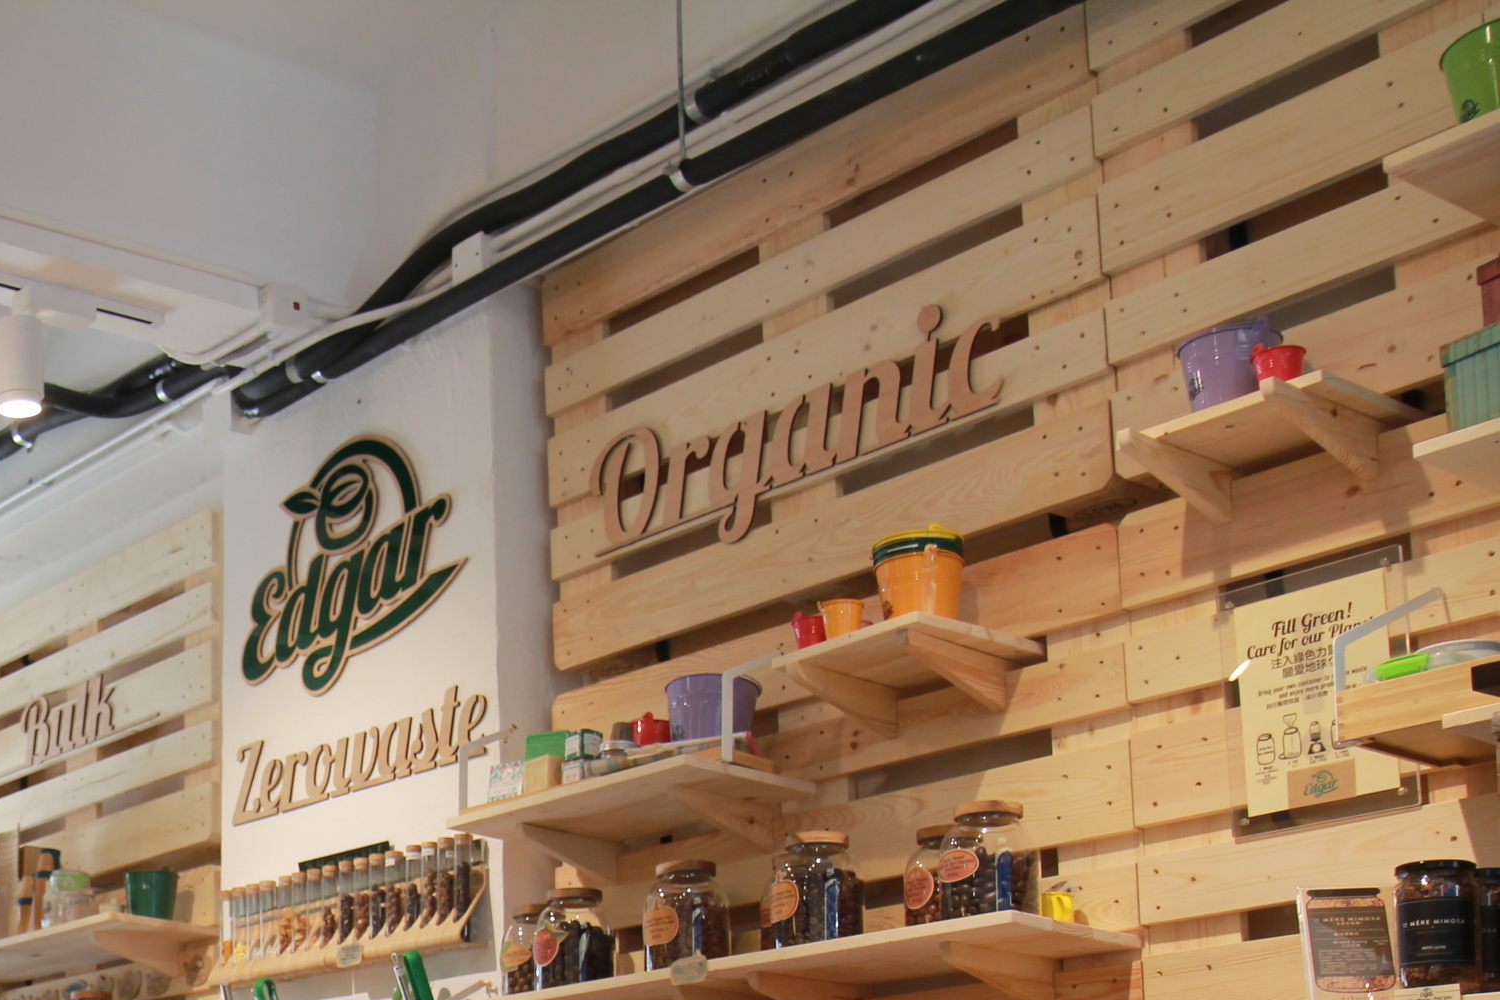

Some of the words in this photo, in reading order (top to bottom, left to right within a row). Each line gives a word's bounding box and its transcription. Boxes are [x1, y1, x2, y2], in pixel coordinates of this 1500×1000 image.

[589, 304, 1004, 550] Organic
[241, 493, 468, 697] Edgar
[1247, 644, 1276, 660] Care
[1278, 637, 1298, 656] for
[1301, 631, 1325, 646] our
[1328, 616, 1374, 639] Pla
[1271, 618, 1296, 638] Fill
[1301, 602, 1353, 633] Green!
[19, 675, 117, 766] Bulk
[232, 685, 488, 827] Zerowaste
[1303, 779, 1339, 798] Edgar
